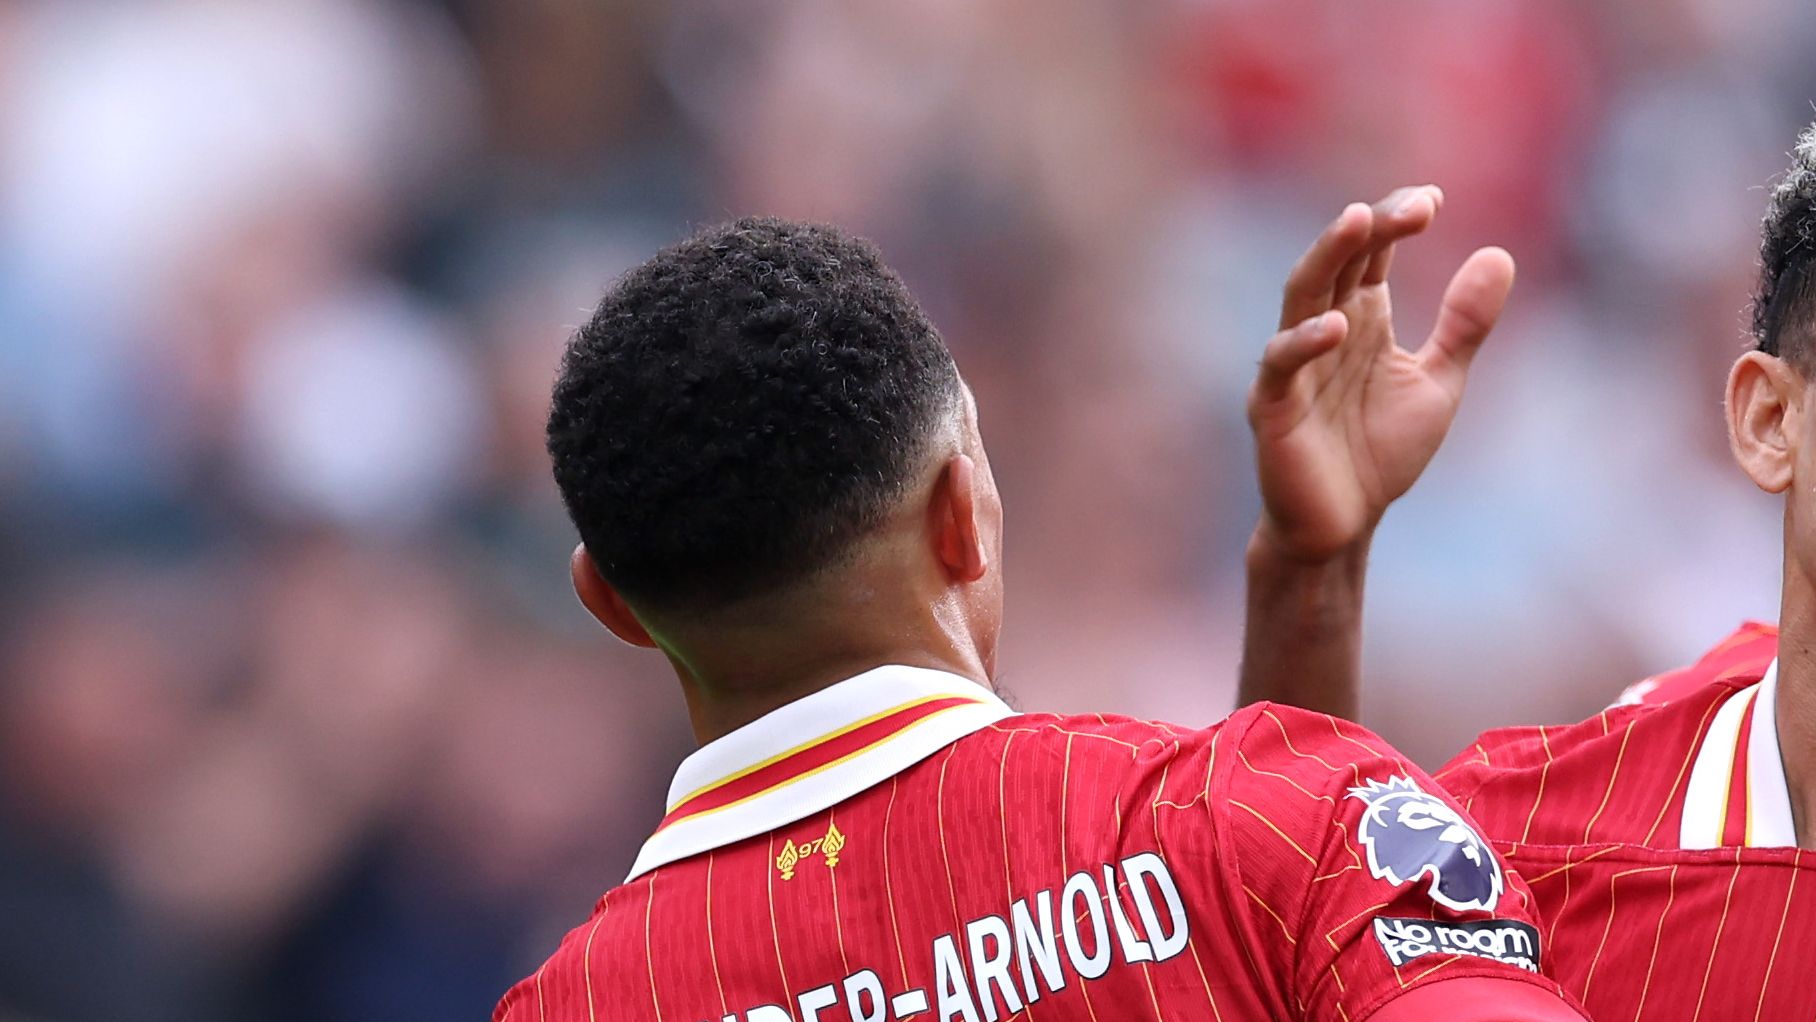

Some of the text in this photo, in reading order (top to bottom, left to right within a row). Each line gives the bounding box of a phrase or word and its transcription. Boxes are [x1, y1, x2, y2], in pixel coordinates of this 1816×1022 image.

[798, 838, 824, 859] 97
[1373, 917, 1534, 957] No room
